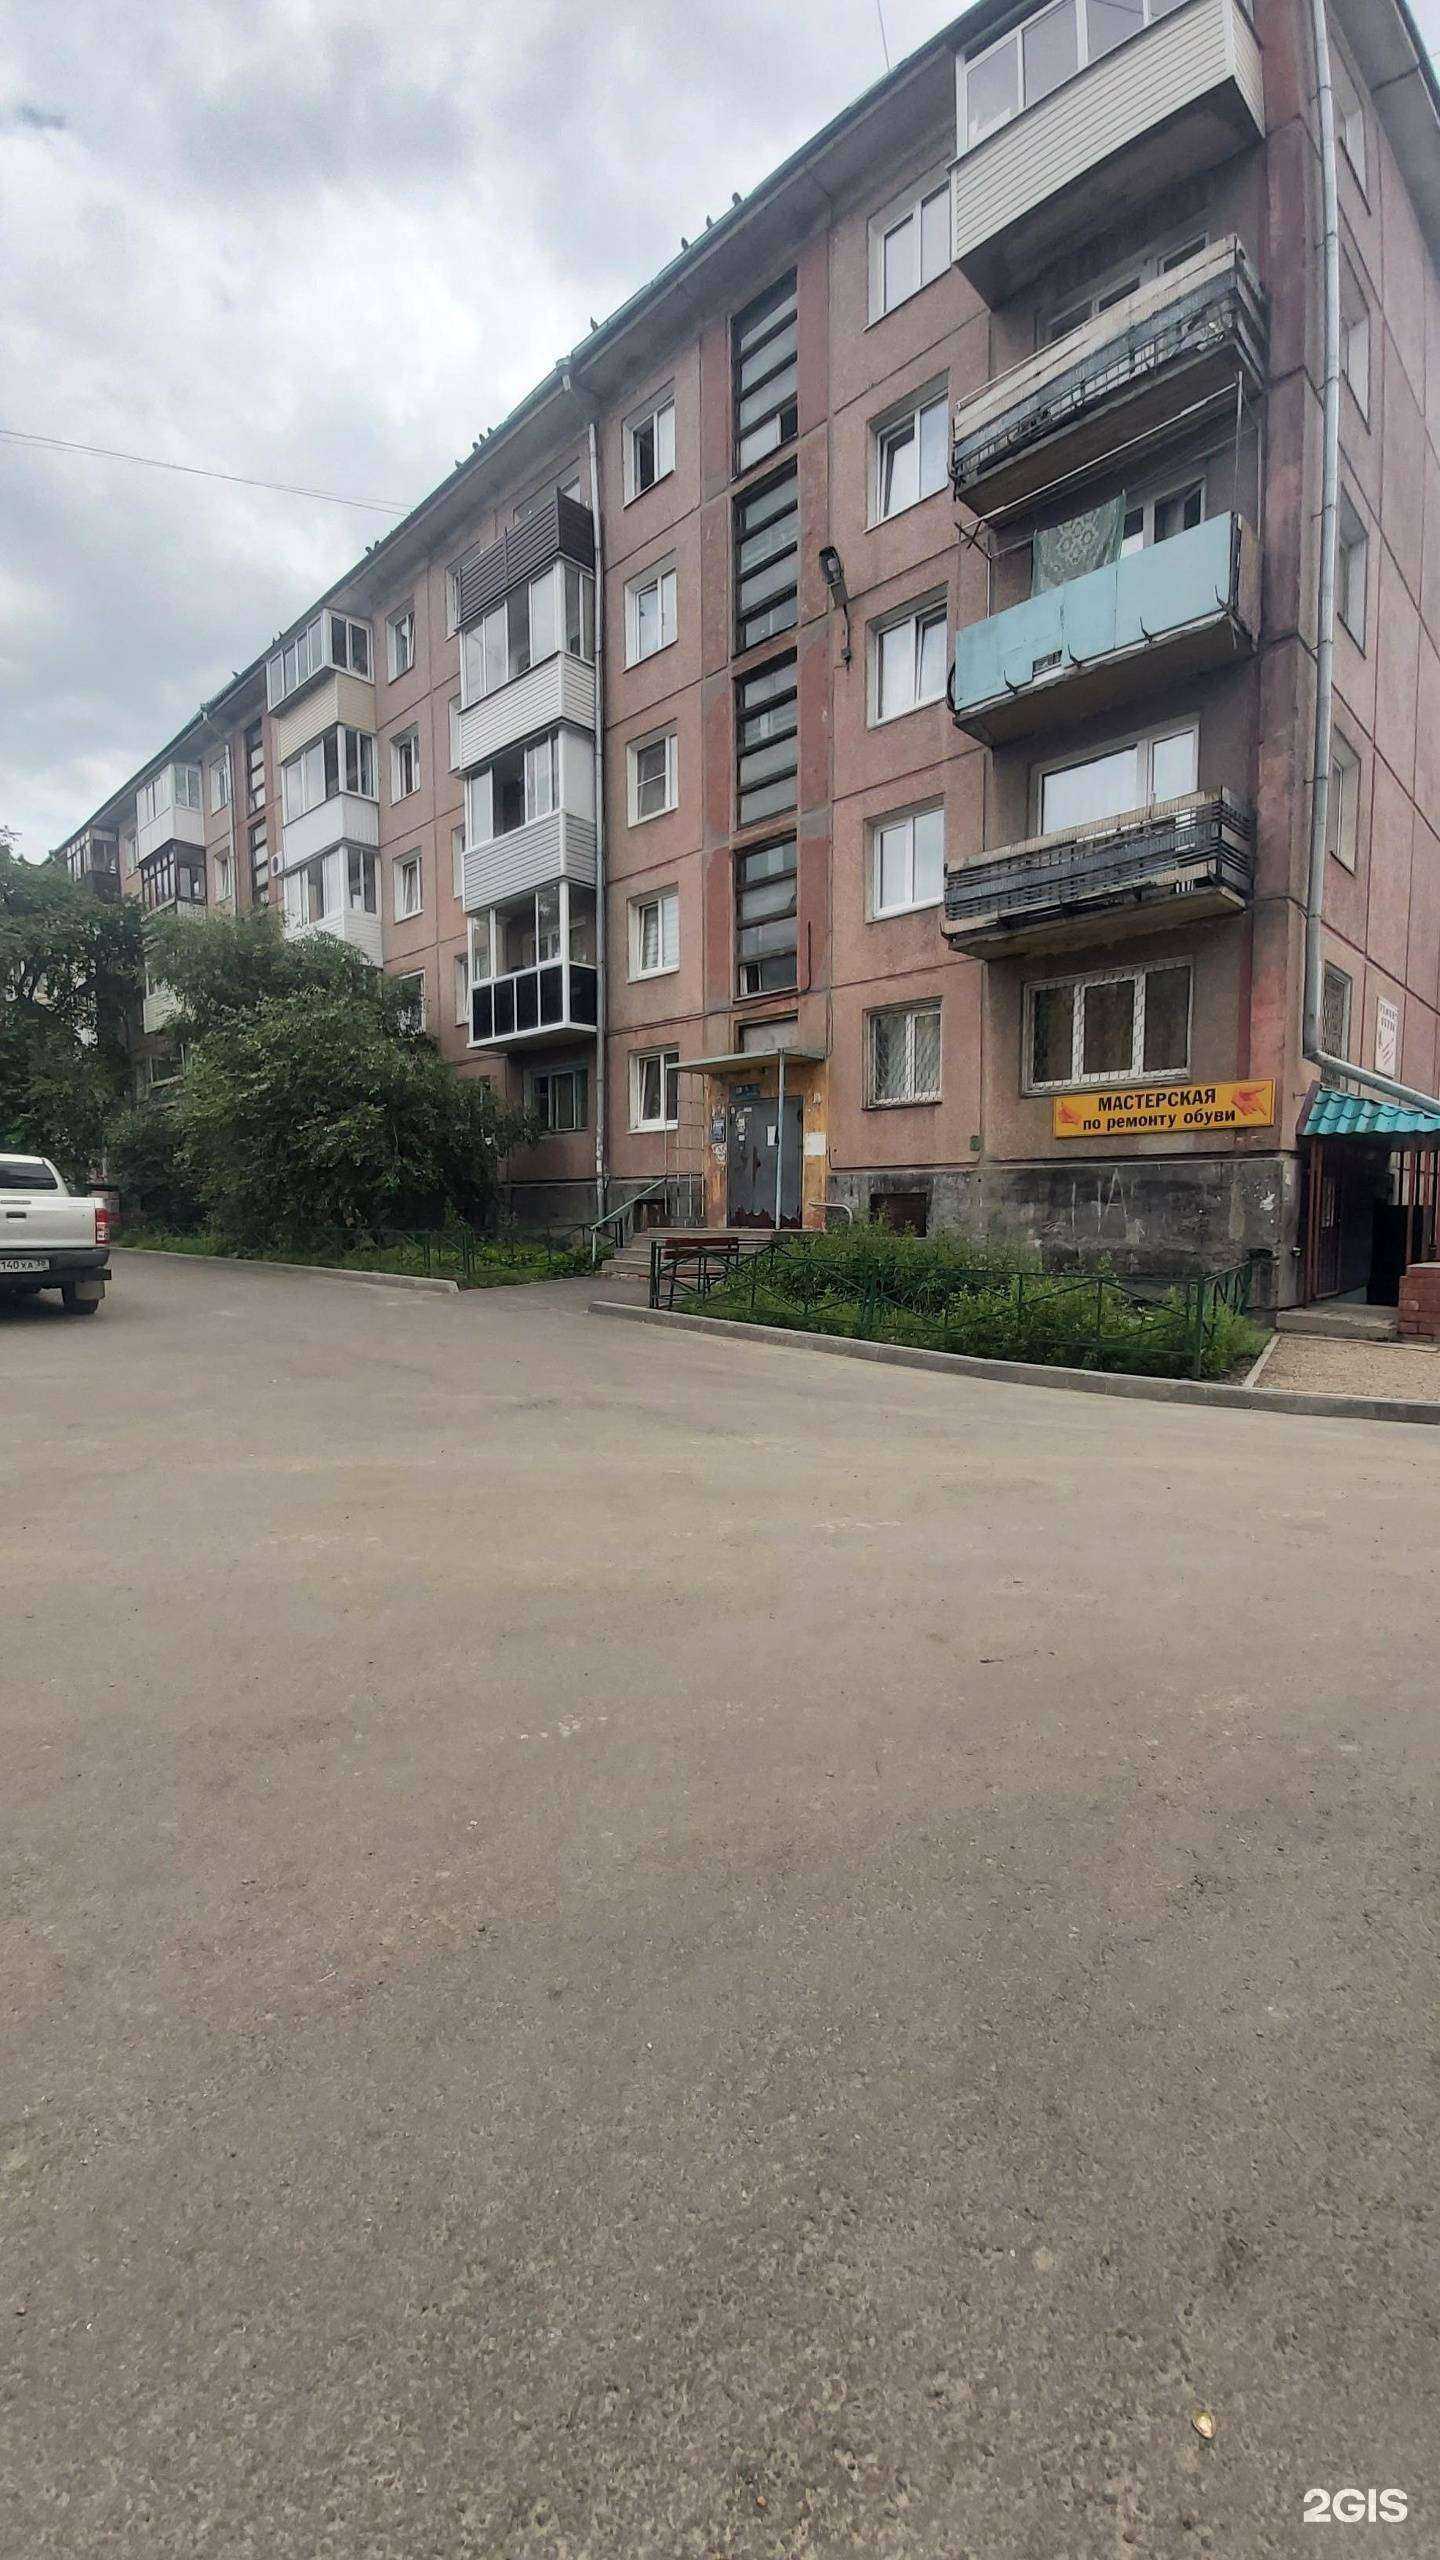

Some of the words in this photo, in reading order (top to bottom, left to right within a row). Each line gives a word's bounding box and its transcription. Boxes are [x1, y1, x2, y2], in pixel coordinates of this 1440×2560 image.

[1098, 1088, 1216, 1112] МАСТЕРСКАЯ
[1083, 1117, 1101, 1130] по
[1106, 1113, 1176, 1131] ремонту
[1183, 1108, 1236, 1125] обуви
